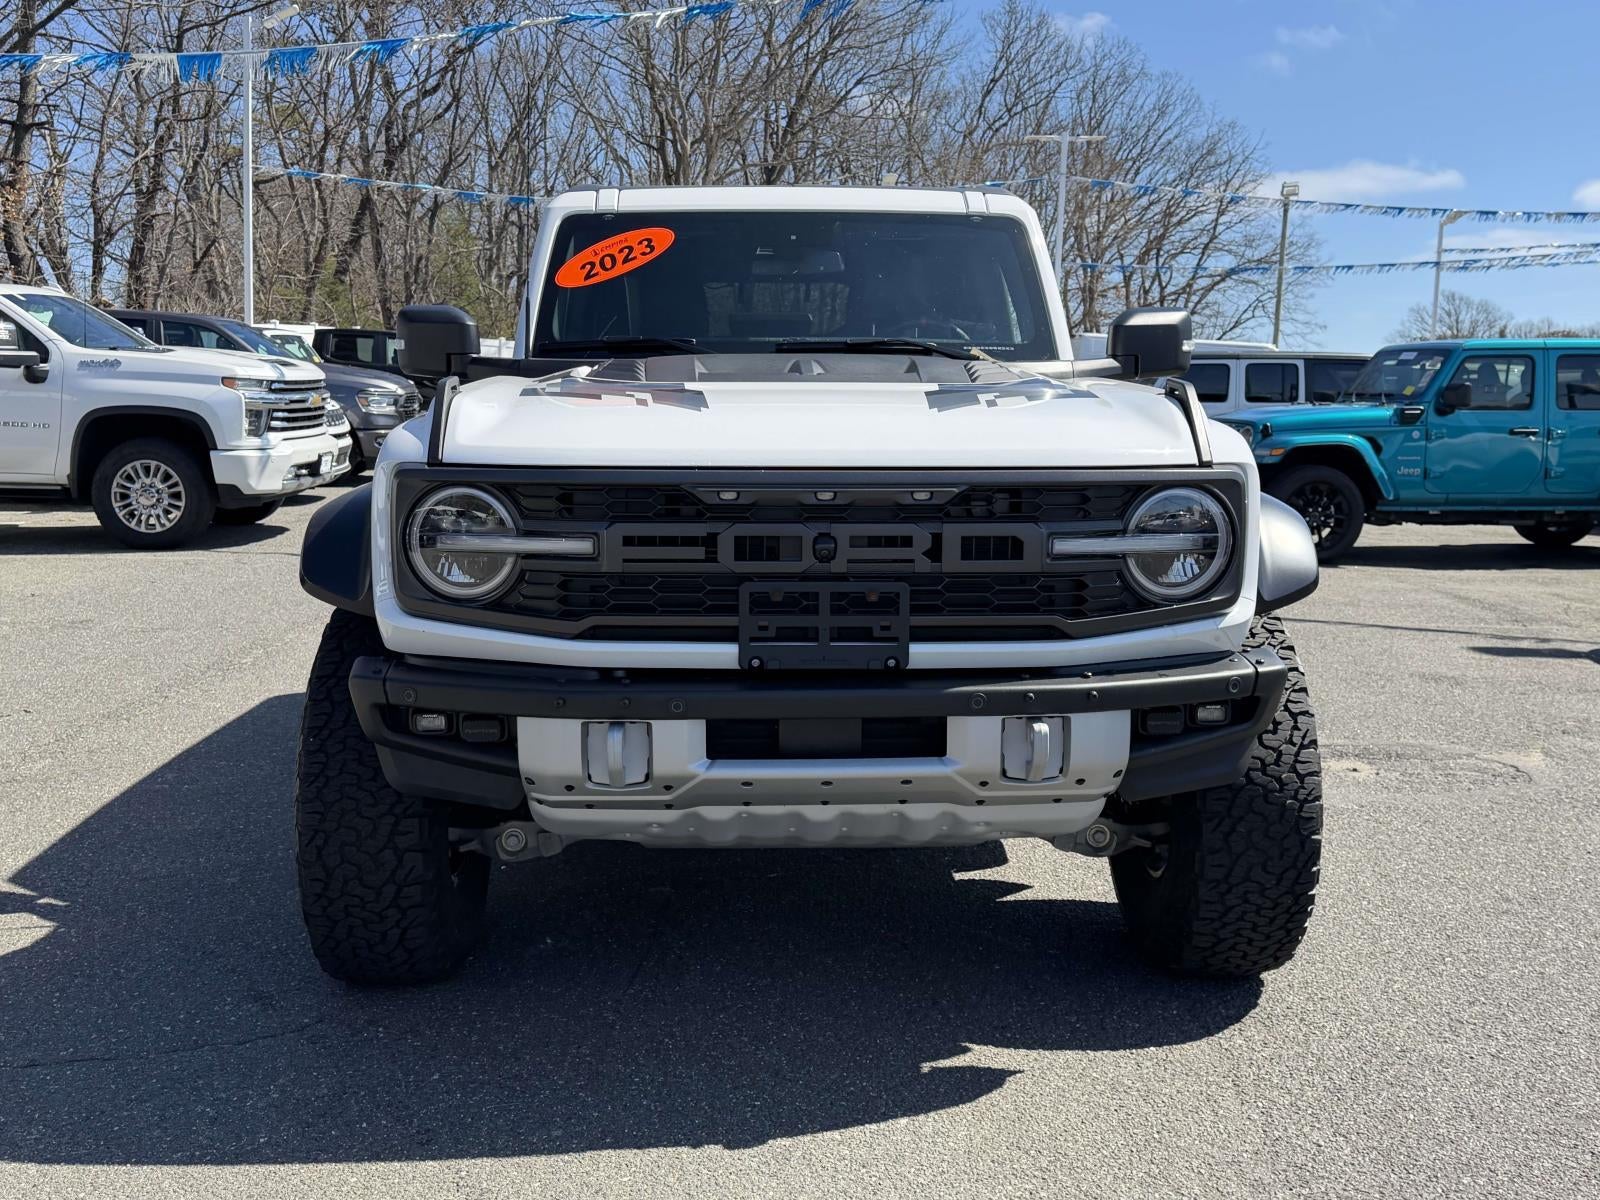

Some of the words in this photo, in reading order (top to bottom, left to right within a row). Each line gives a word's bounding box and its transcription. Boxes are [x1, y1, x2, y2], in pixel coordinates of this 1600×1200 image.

[579, 238, 656, 282] 2023
[1397, 465, 1421, 476] Jeep
[605, 522, 1042, 573] FORD
